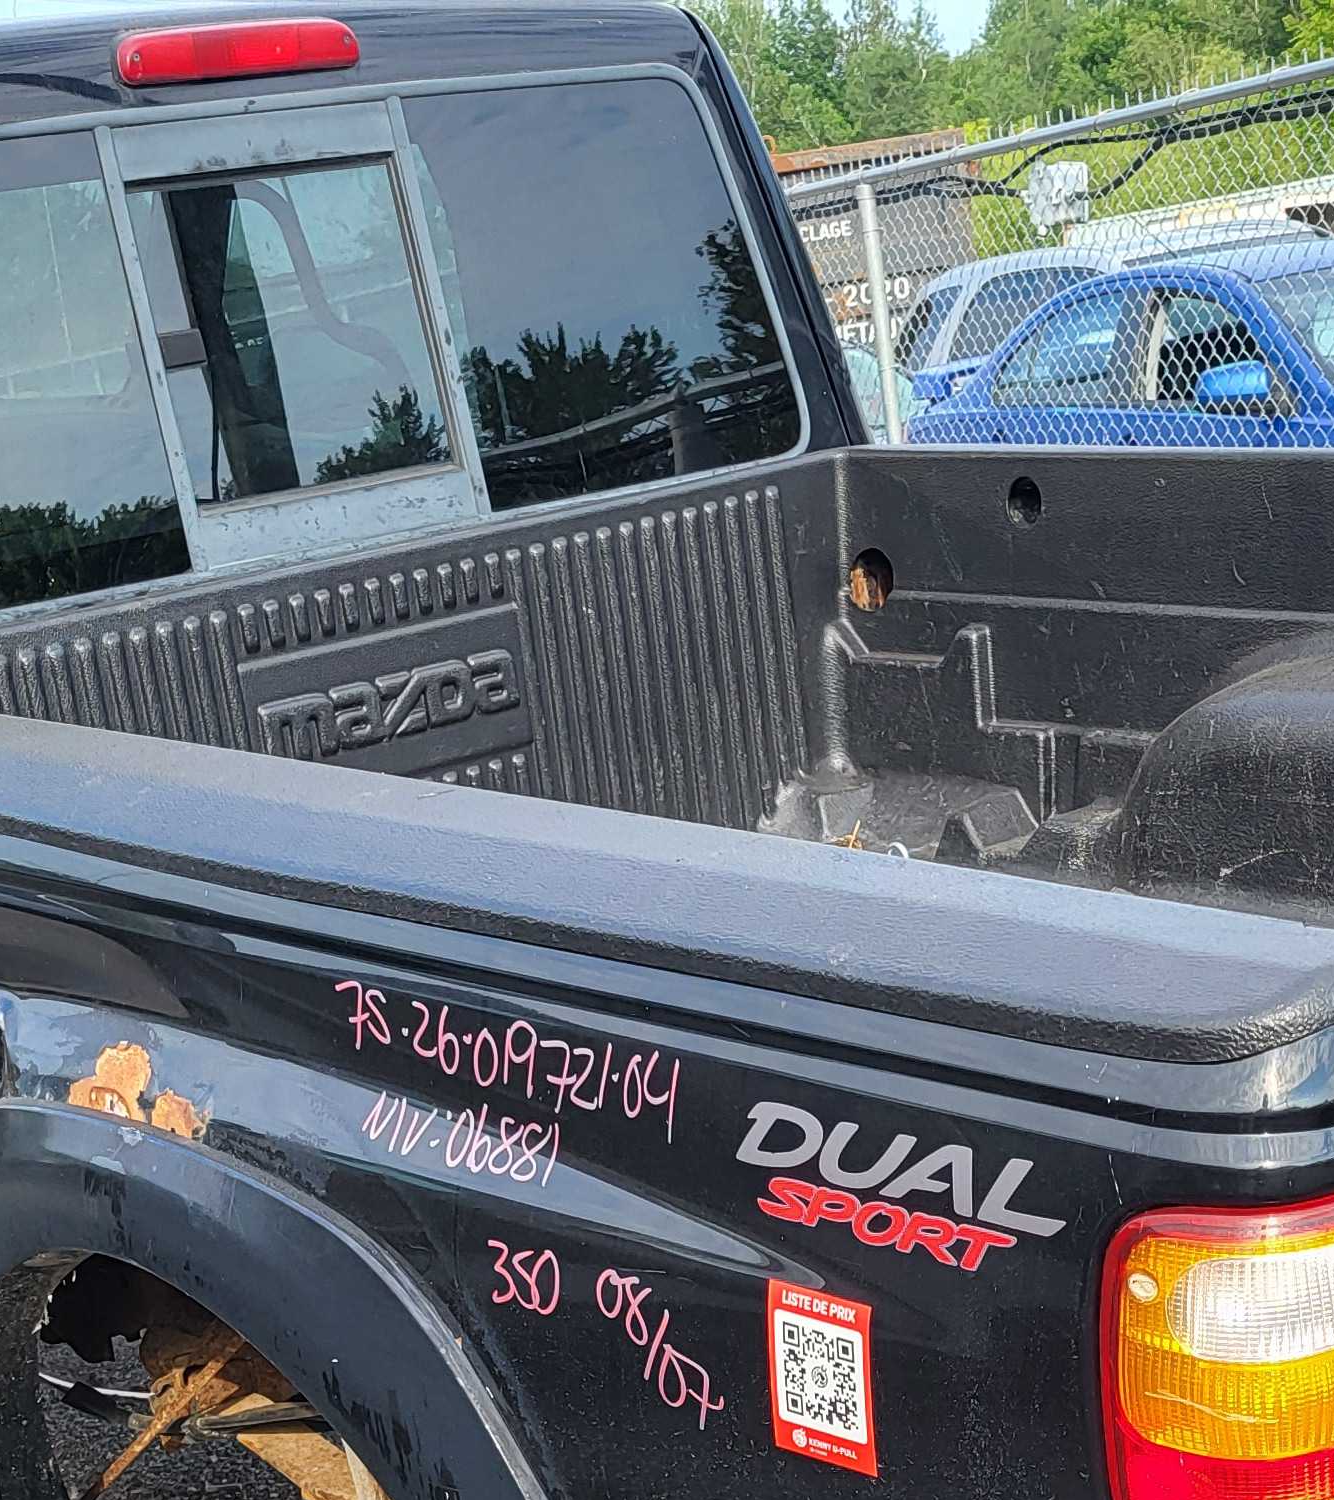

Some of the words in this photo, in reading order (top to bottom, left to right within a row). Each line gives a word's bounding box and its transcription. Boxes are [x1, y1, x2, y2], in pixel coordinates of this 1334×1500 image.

[735, 1101, 1067, 1237] DUAL
[757, 1176, 1018, 1272] SPORT
[486, 1239, 560, 1316] 350
[781, 1289, 812, 1311] LISTE
[812, 1296, 829, 1316] DE
[828, 1303, 857, 1325] PRIX
